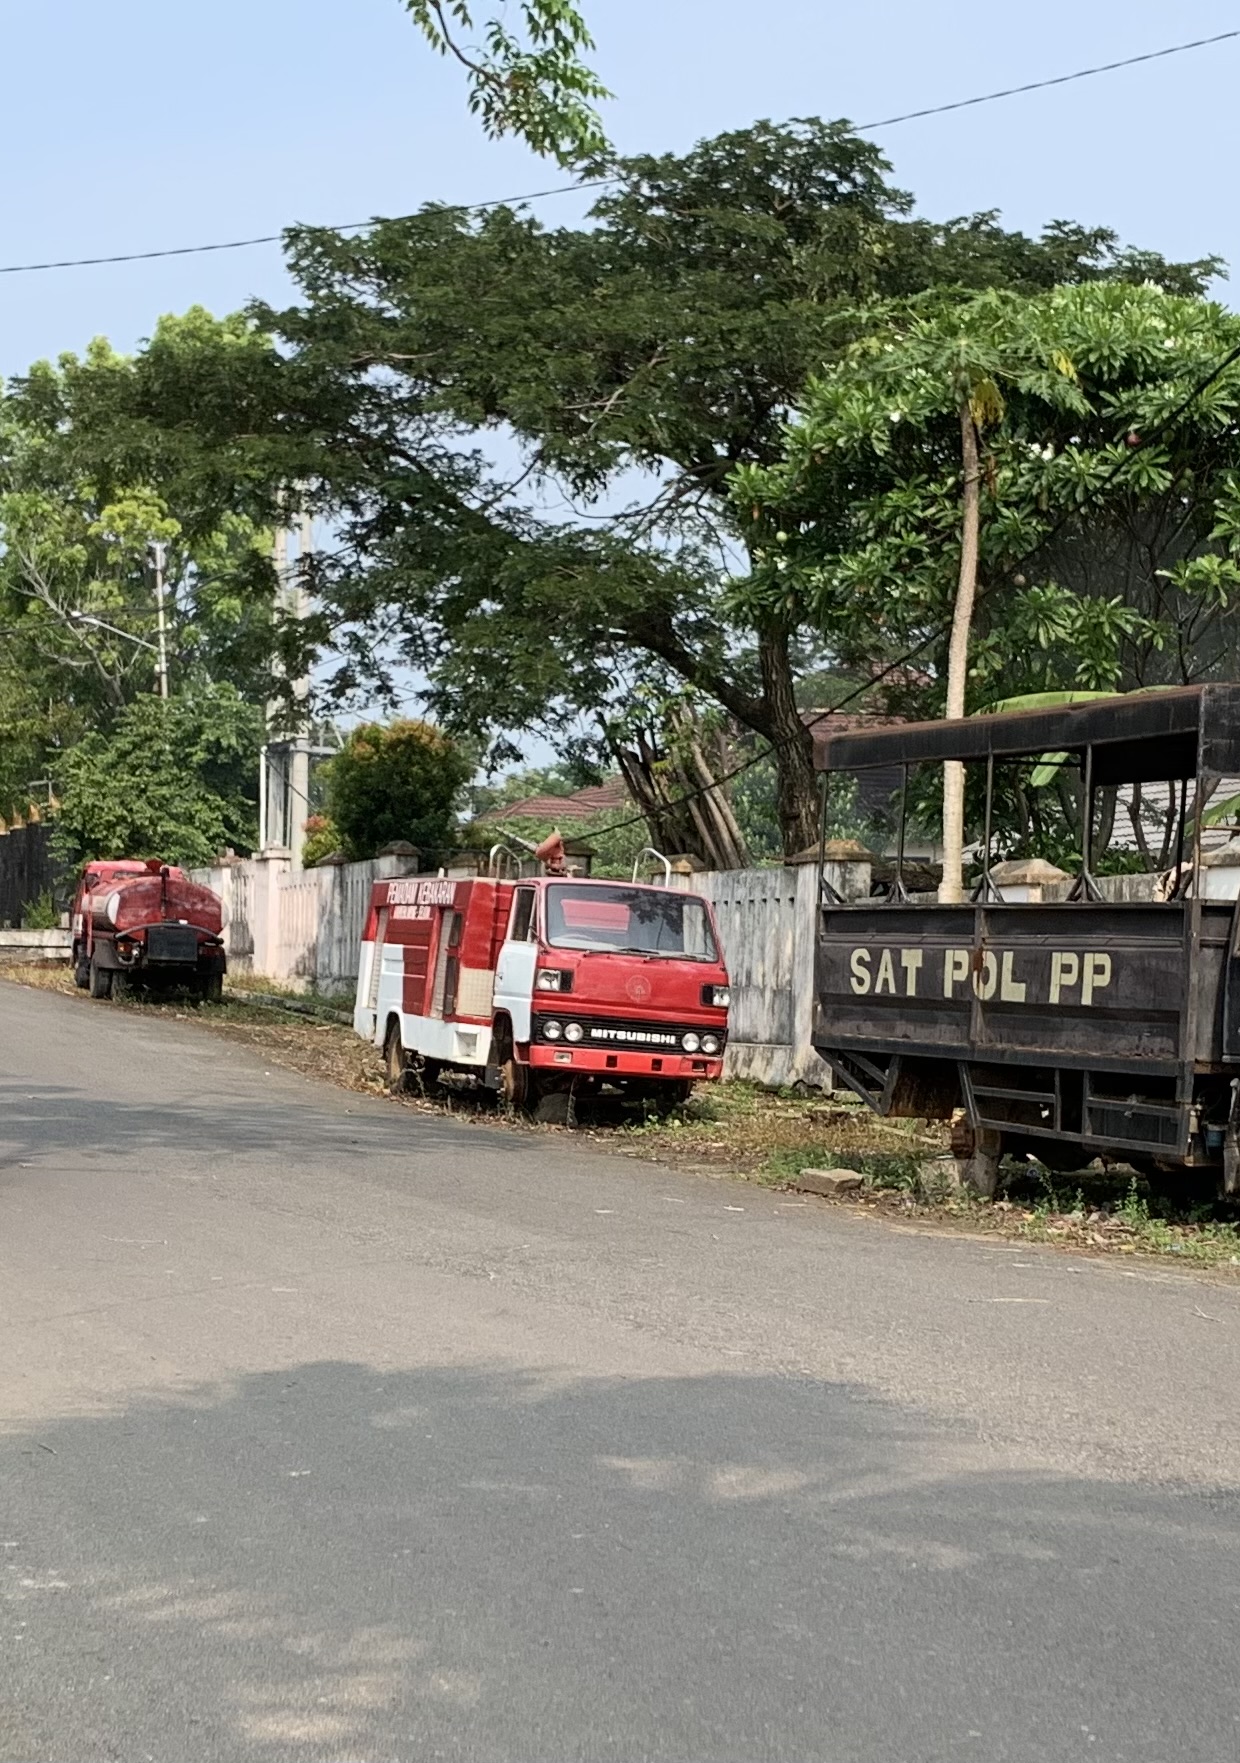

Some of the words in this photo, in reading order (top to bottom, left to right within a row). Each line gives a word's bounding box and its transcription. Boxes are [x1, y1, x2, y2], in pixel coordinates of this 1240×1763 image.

[850, 947, 923, 997] SAT
[943, 948, 1026, 1002] POL
[1048, 951, 1112, 1006] PP
[590, 1028, 676, 1044] MITSUBISHI
